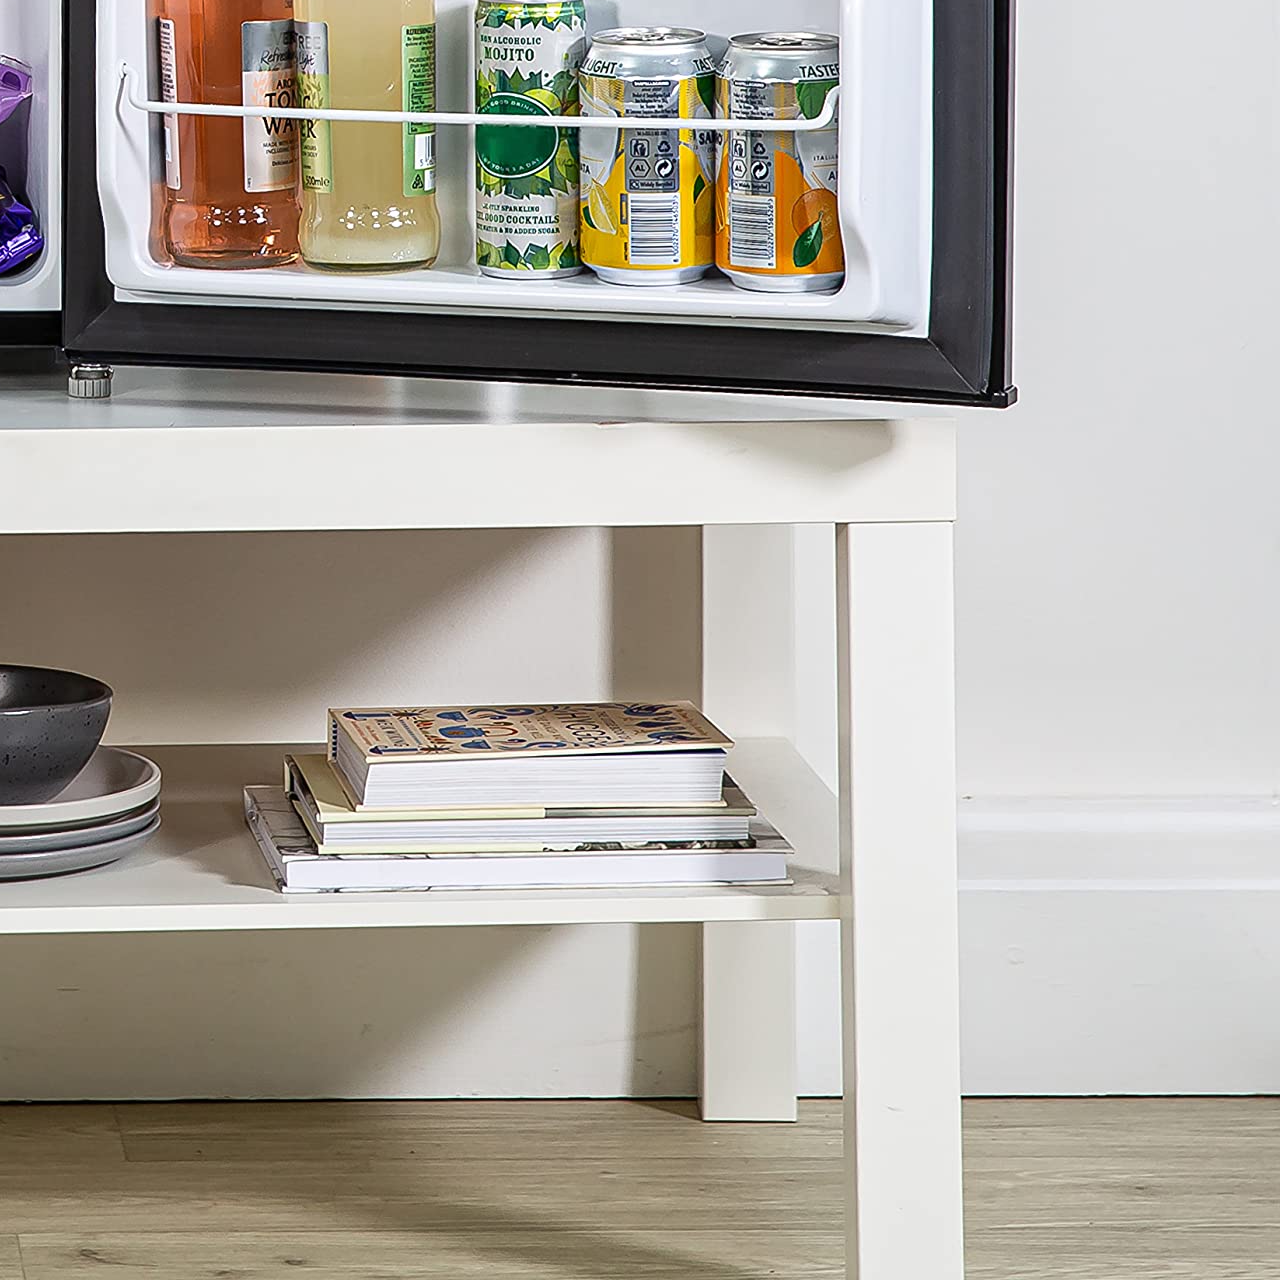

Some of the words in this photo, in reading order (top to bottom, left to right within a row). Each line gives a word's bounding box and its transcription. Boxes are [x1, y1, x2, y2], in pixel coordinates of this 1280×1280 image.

[493, 36, 542, 45] ALCOHOLIC
[484, 46, 535, 62] MOJITO
[634, 164, 646, 172] AL
[639, 181, 655, 189] Widely
[484, 212, 505, 223] GOOD
[506, 214, 560, 225] COCKTAILS
[553, 712, 613, 741] HYGGE
